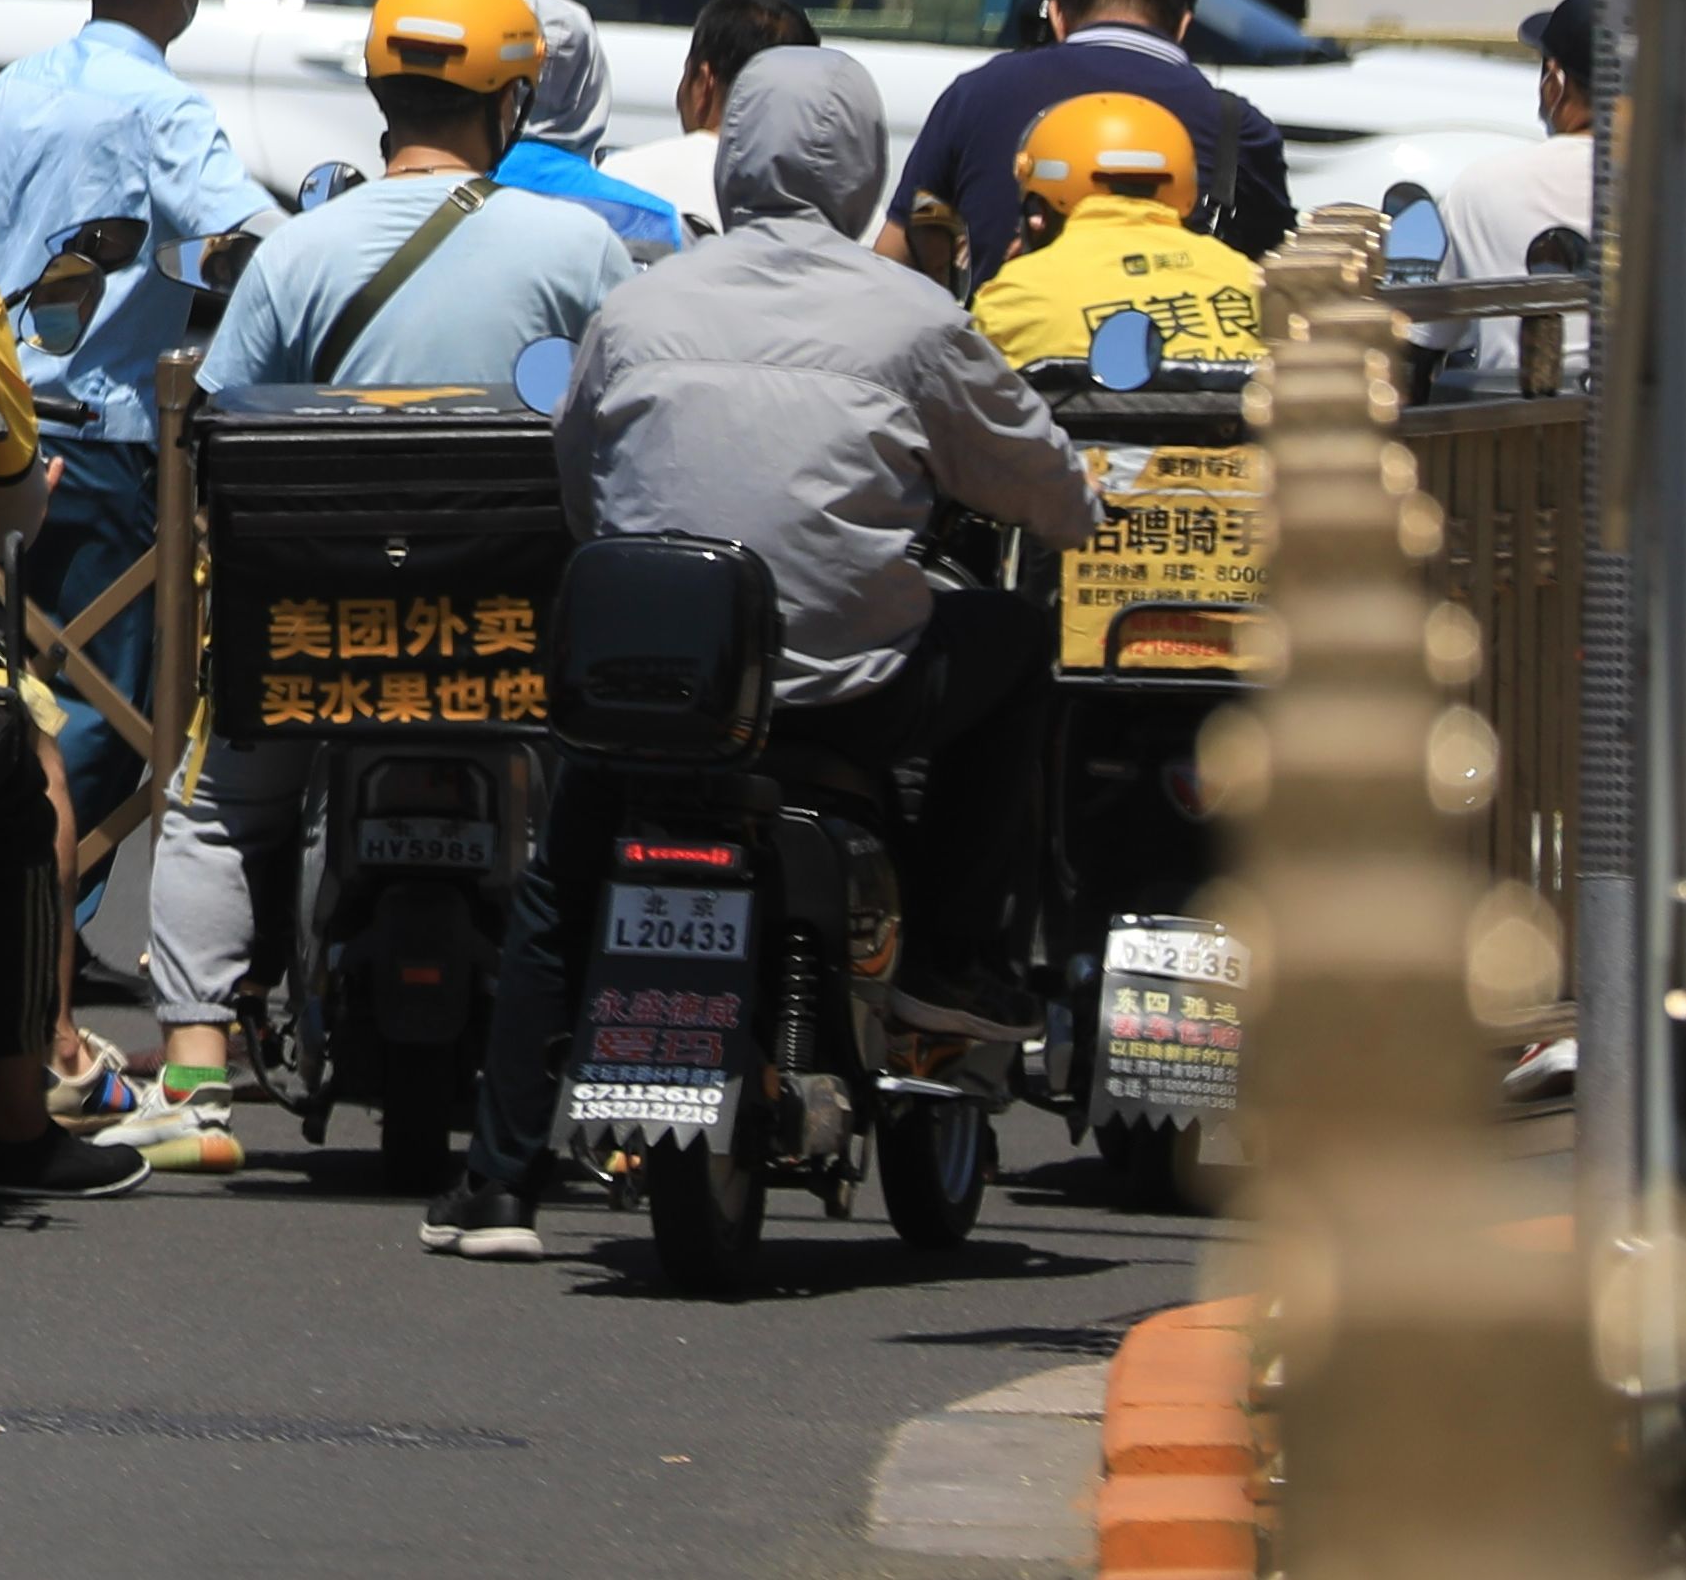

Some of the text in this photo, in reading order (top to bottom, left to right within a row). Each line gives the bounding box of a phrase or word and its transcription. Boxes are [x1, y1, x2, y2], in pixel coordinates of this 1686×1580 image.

[269, 597, 536, 659] 美团外卖
[262, 668, 548, 726] 买水果也快
[642, 894, 715, 917] 北京
[616, 919, 736, 952] L20433
